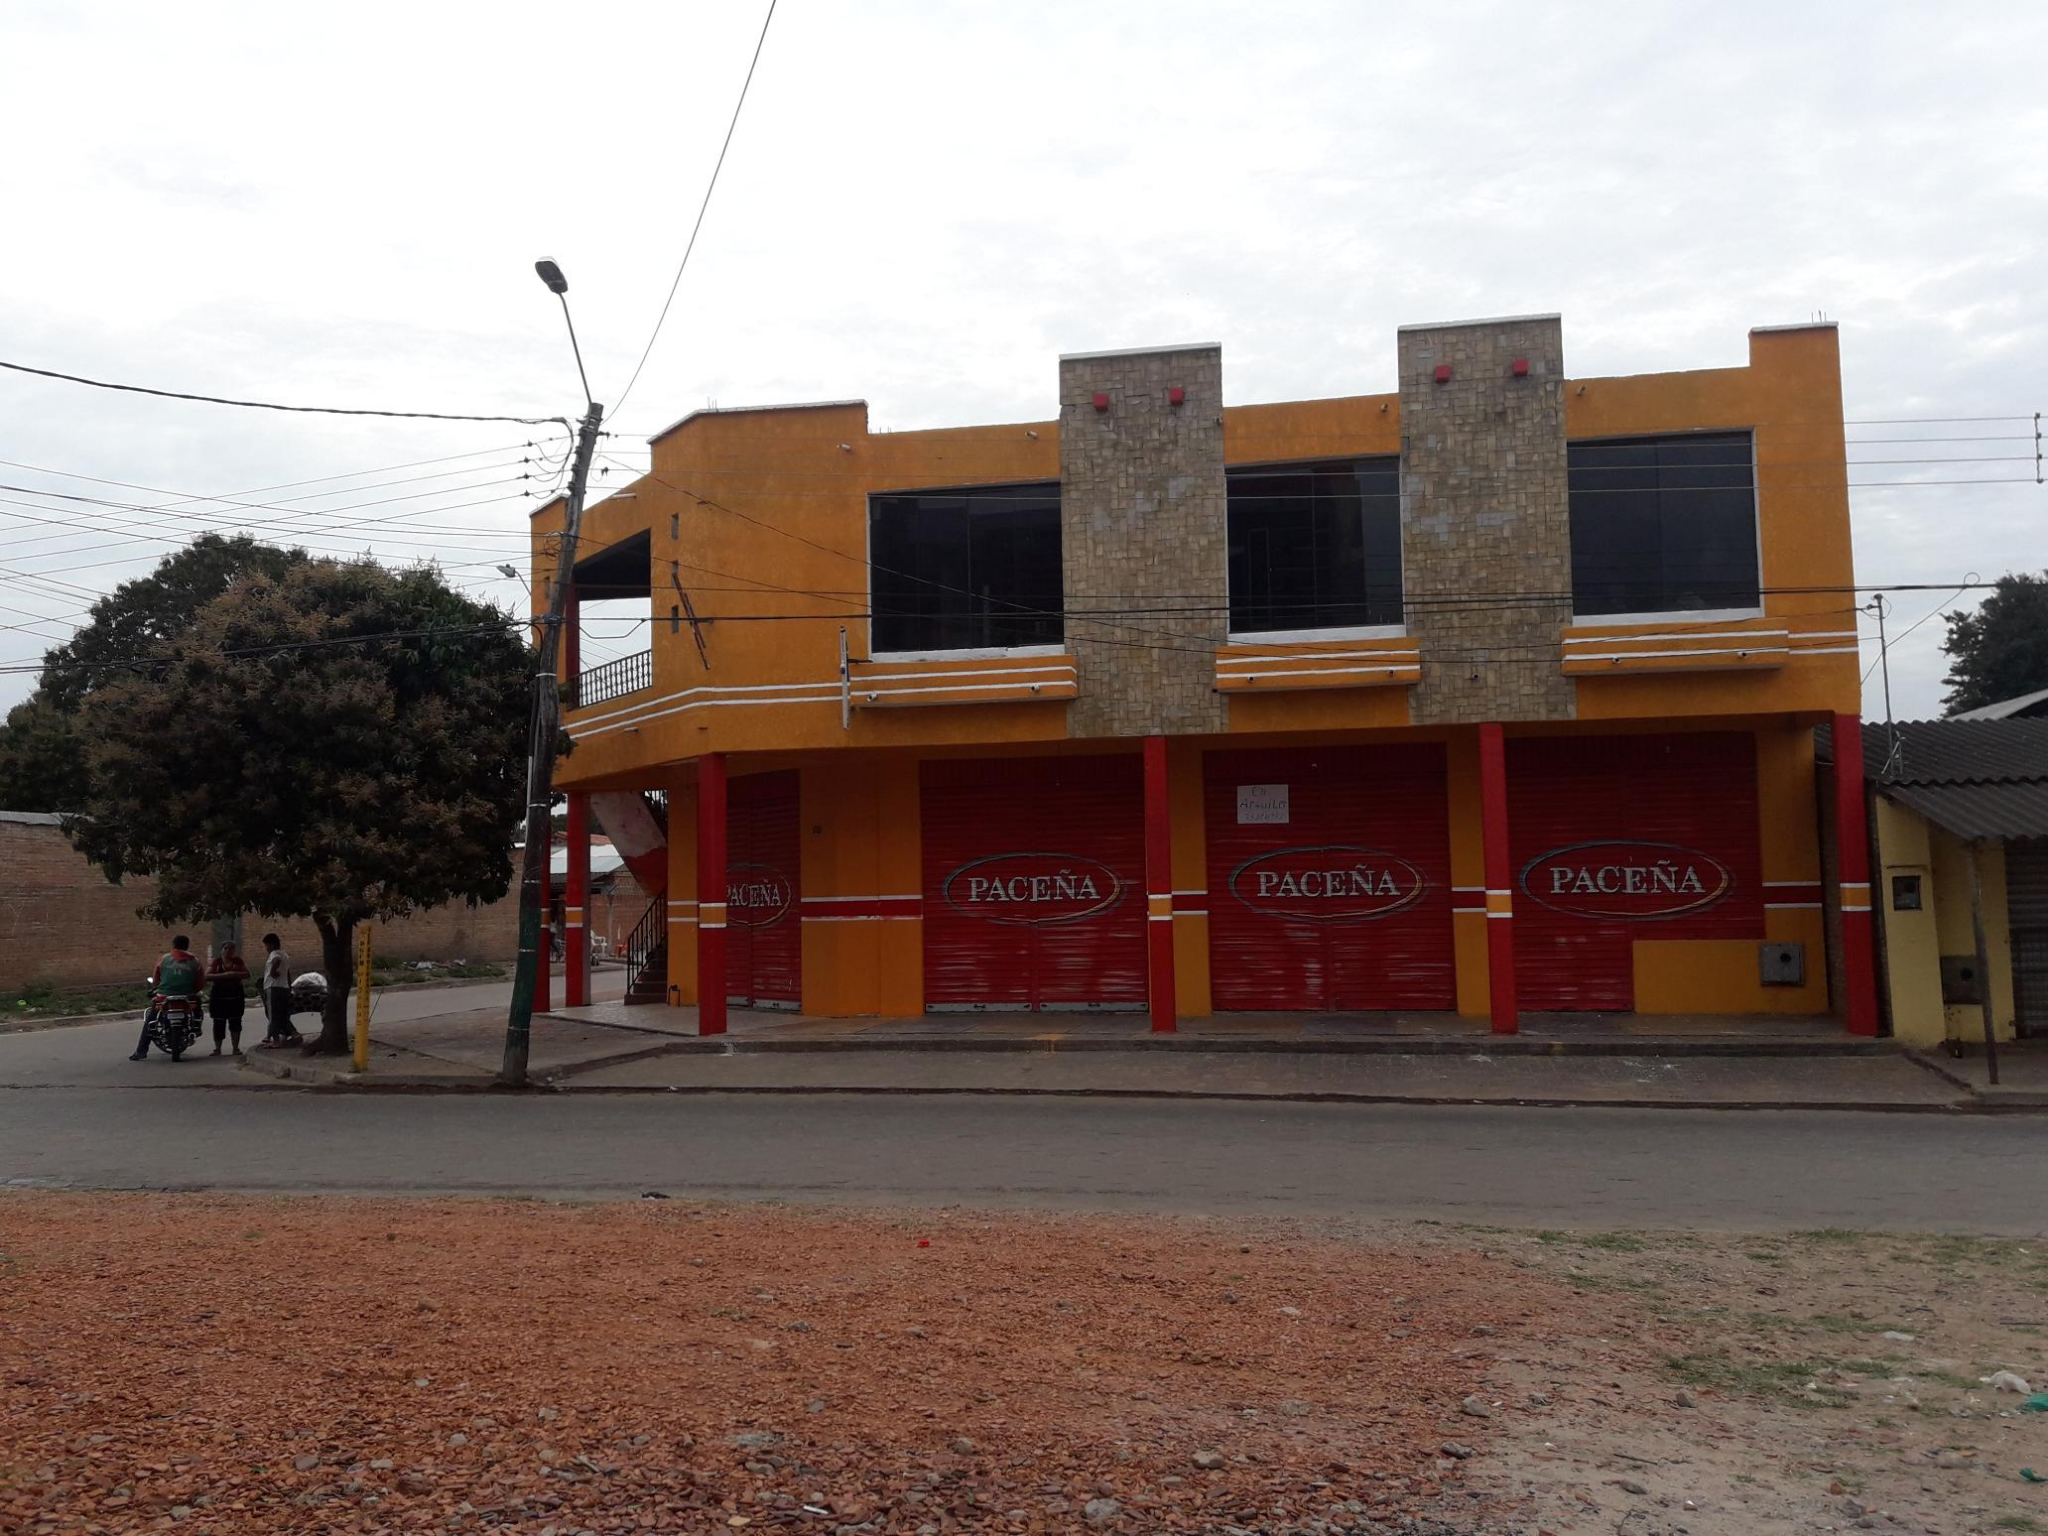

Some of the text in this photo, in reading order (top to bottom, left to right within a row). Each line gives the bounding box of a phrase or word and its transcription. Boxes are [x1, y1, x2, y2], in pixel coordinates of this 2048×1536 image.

[967, 868, 1101, 902] PACEÑA
[1256, 863, 1401, 898] PACEÑA
[1550, 859, 1706, 894] PACEÑA
